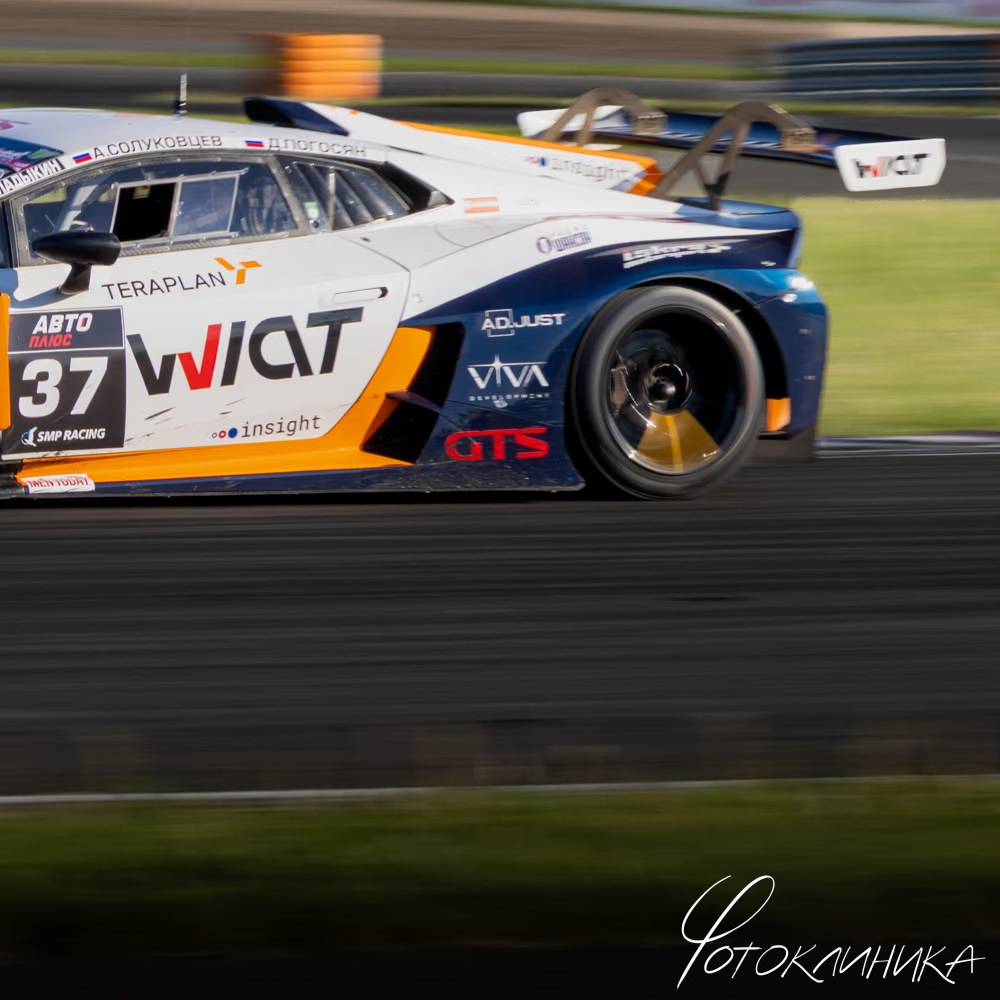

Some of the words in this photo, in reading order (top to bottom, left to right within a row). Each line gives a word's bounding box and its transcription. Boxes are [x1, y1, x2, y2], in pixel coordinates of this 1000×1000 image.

[101, 270, 227, 300] TERAPLAN
[31, 312, 93, 335] АВТО
[28, 333, 73, 349] ПЛЮС
[466, 354, 550, 390] VIVA
[18, 356, 109, 419] 37
[37, 430, 63, 443] SMP
[63, 428, 107, 441] RACING
[240, 414, 322, 440] insight
[444, 427, 550, 462] GTS
